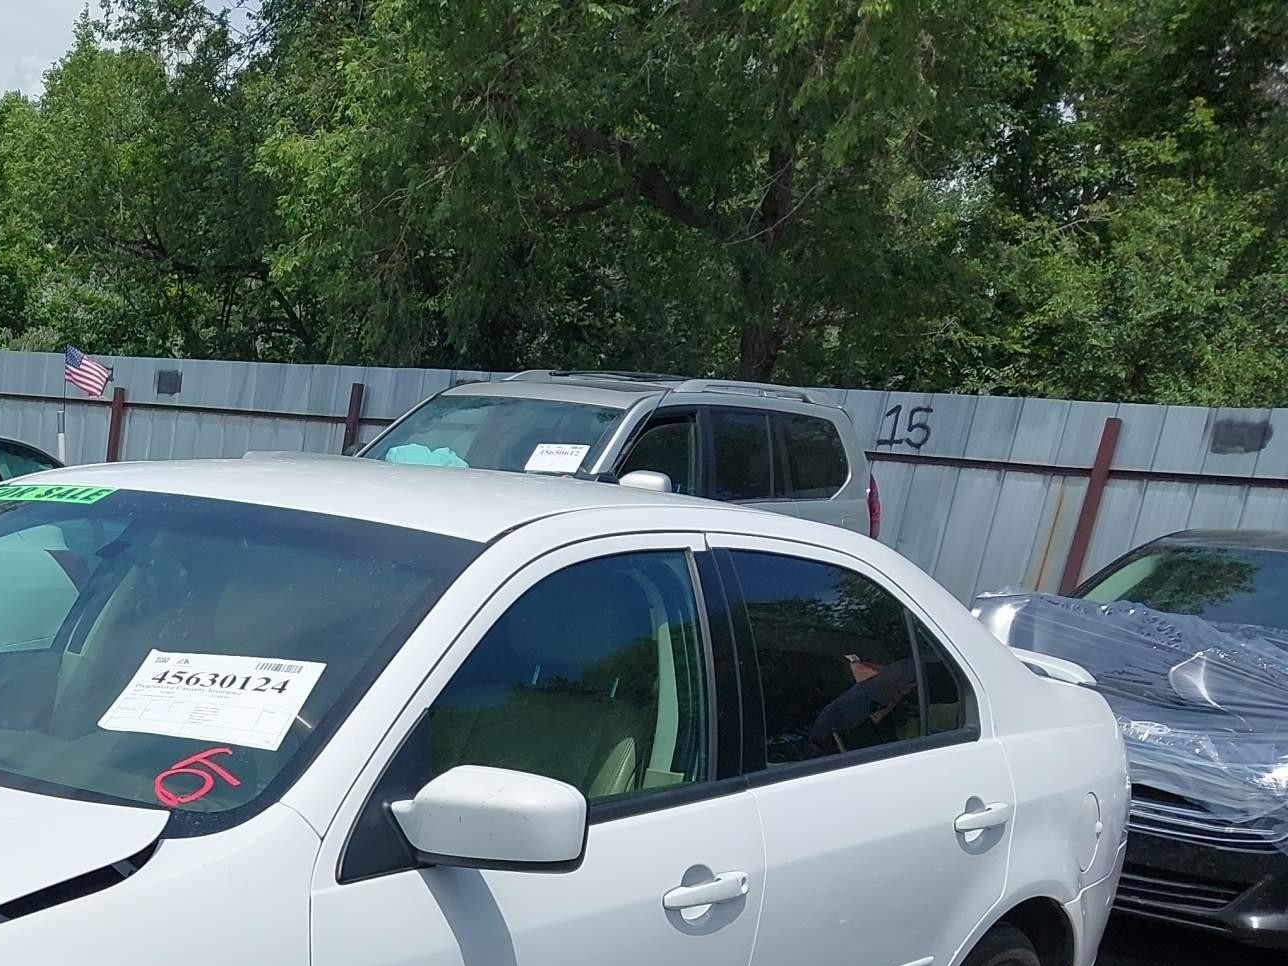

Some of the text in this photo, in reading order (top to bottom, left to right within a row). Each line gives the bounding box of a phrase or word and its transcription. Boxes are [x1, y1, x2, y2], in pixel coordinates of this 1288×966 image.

[876, 404, 934, 450] 15
[34, 486, 113, 501] SALE
[151, 669, 291, 694] 45630124
